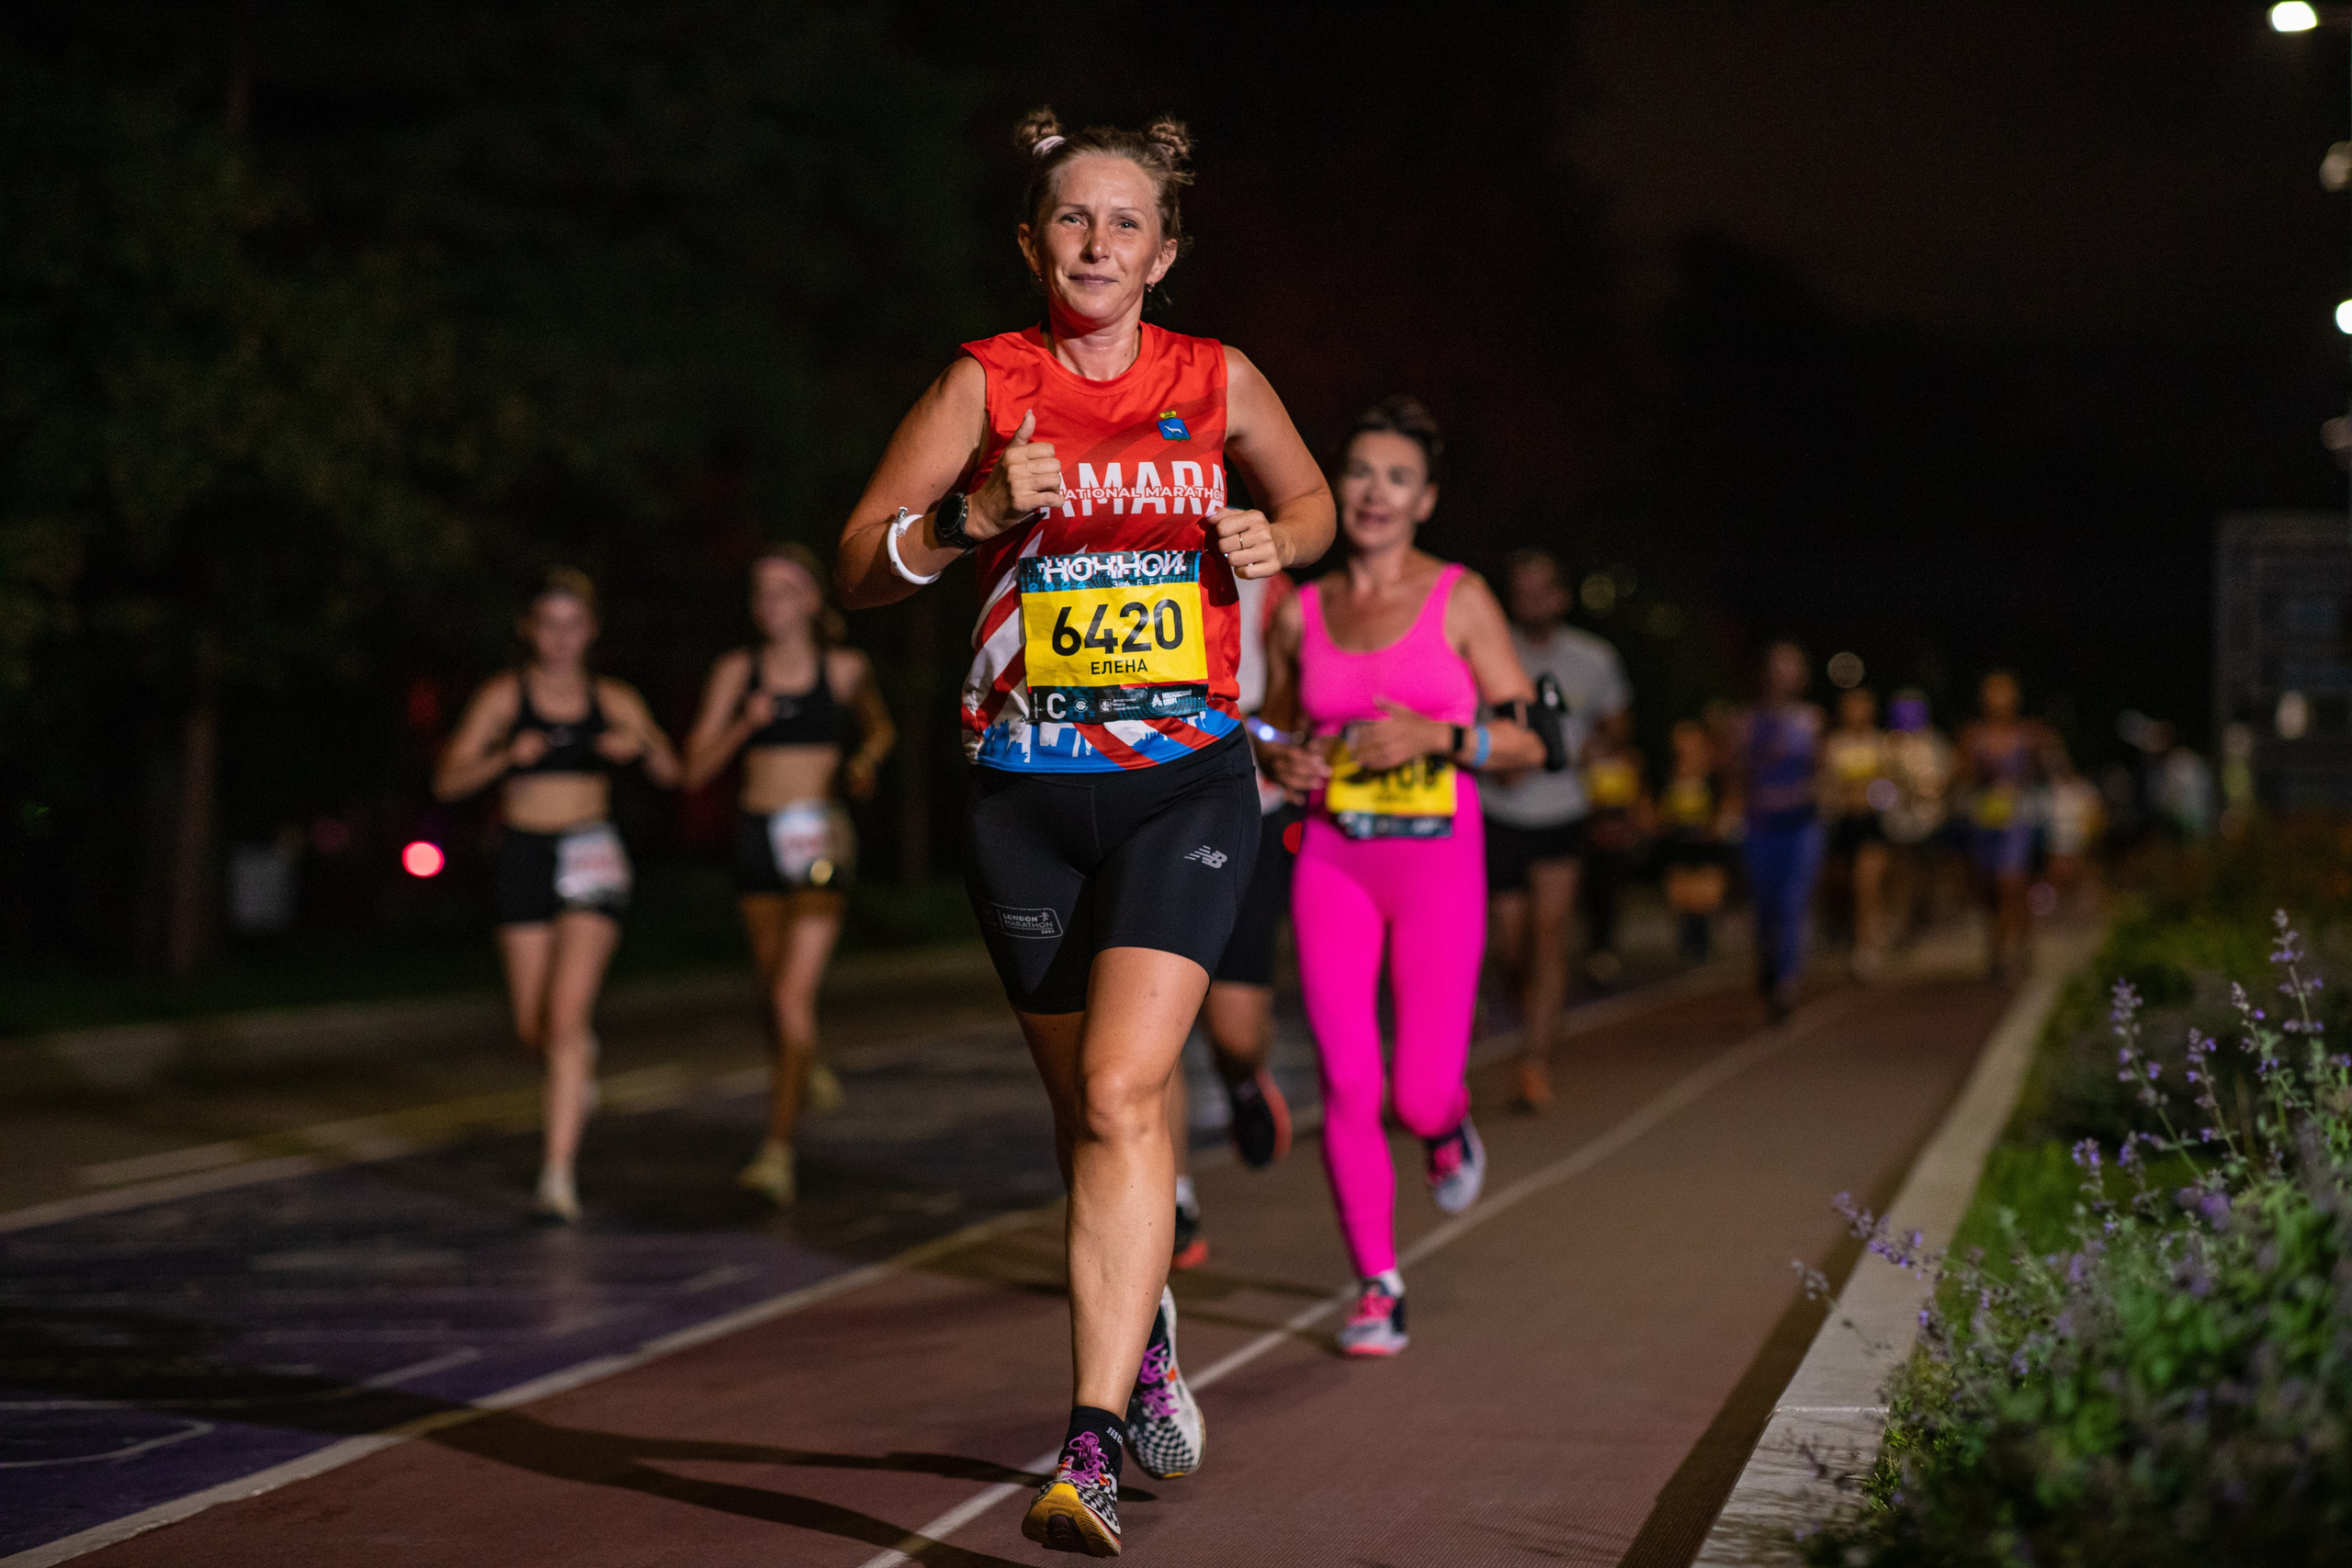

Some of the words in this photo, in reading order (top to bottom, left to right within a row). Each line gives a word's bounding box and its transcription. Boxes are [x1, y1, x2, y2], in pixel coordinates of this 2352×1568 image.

[1039, 461, 1225, 521] AMARA
[1059, 487, 1140, 500] ATIONAL
[1028, 581, 1087, 593] 2024
[1051, 598, 1184, 657] 6420
[1091, 658, 1148, 675] ЕЛЕНА
[1002, 913, 1038, 922] LONDON
[1004, 919, 1053, 929] MARATHON
